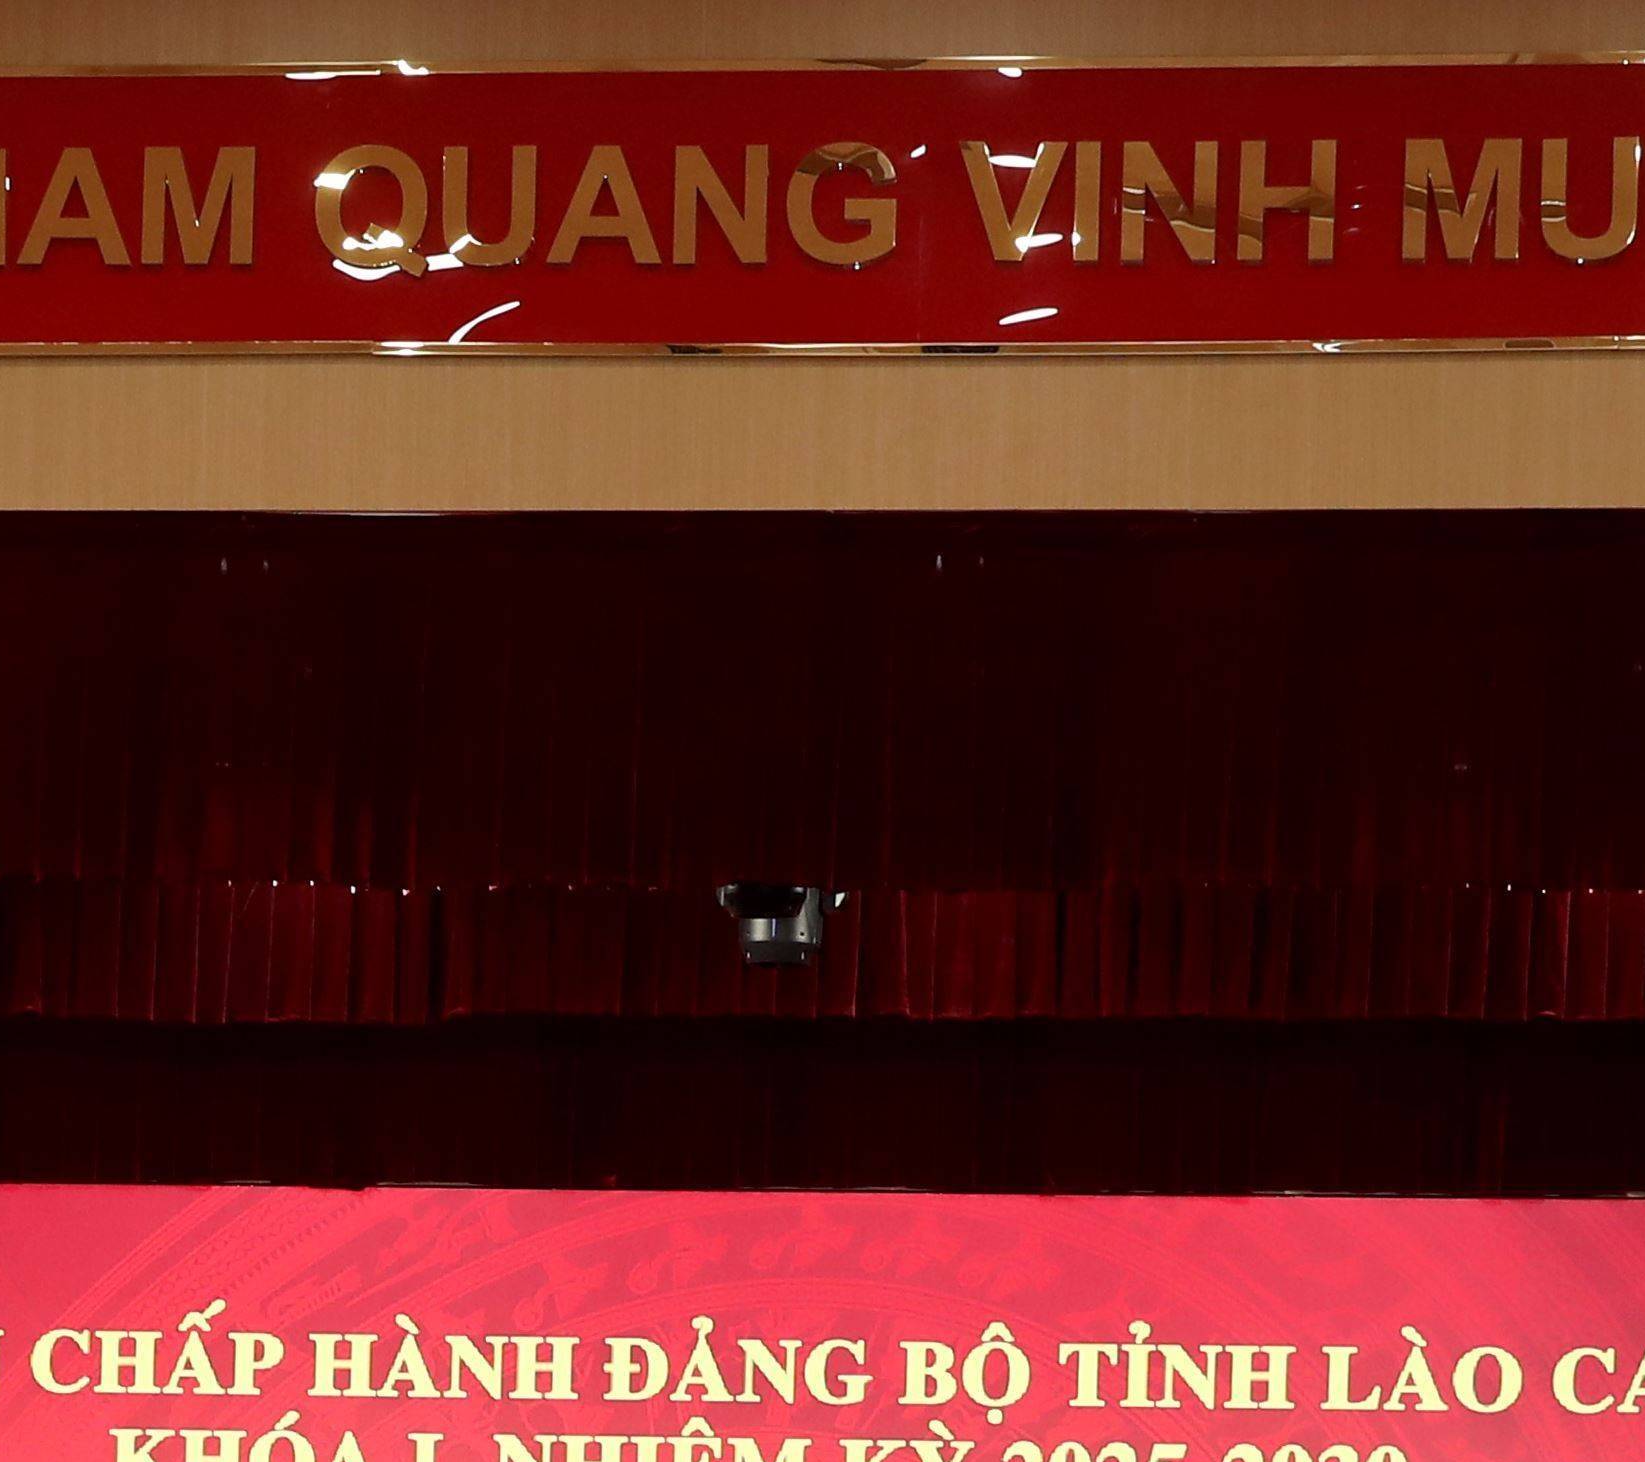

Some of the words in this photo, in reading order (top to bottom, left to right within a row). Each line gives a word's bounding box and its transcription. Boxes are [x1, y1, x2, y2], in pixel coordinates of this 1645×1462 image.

[314, 142, 898, 277] QUANG
[959, 139, 1335, 264] VINH
[31, 1300, 284, 1395] CHẤP
[308, 1314, 579, 1399] HÀNH
[604, 1316, 873, 1404] ĐẢNG
[899, 1322, 1029, 1424] BỘ
[1059, 1321, 1296, 1409] TỈNH
[1321, 1326, 1522, 1412] LÀO
